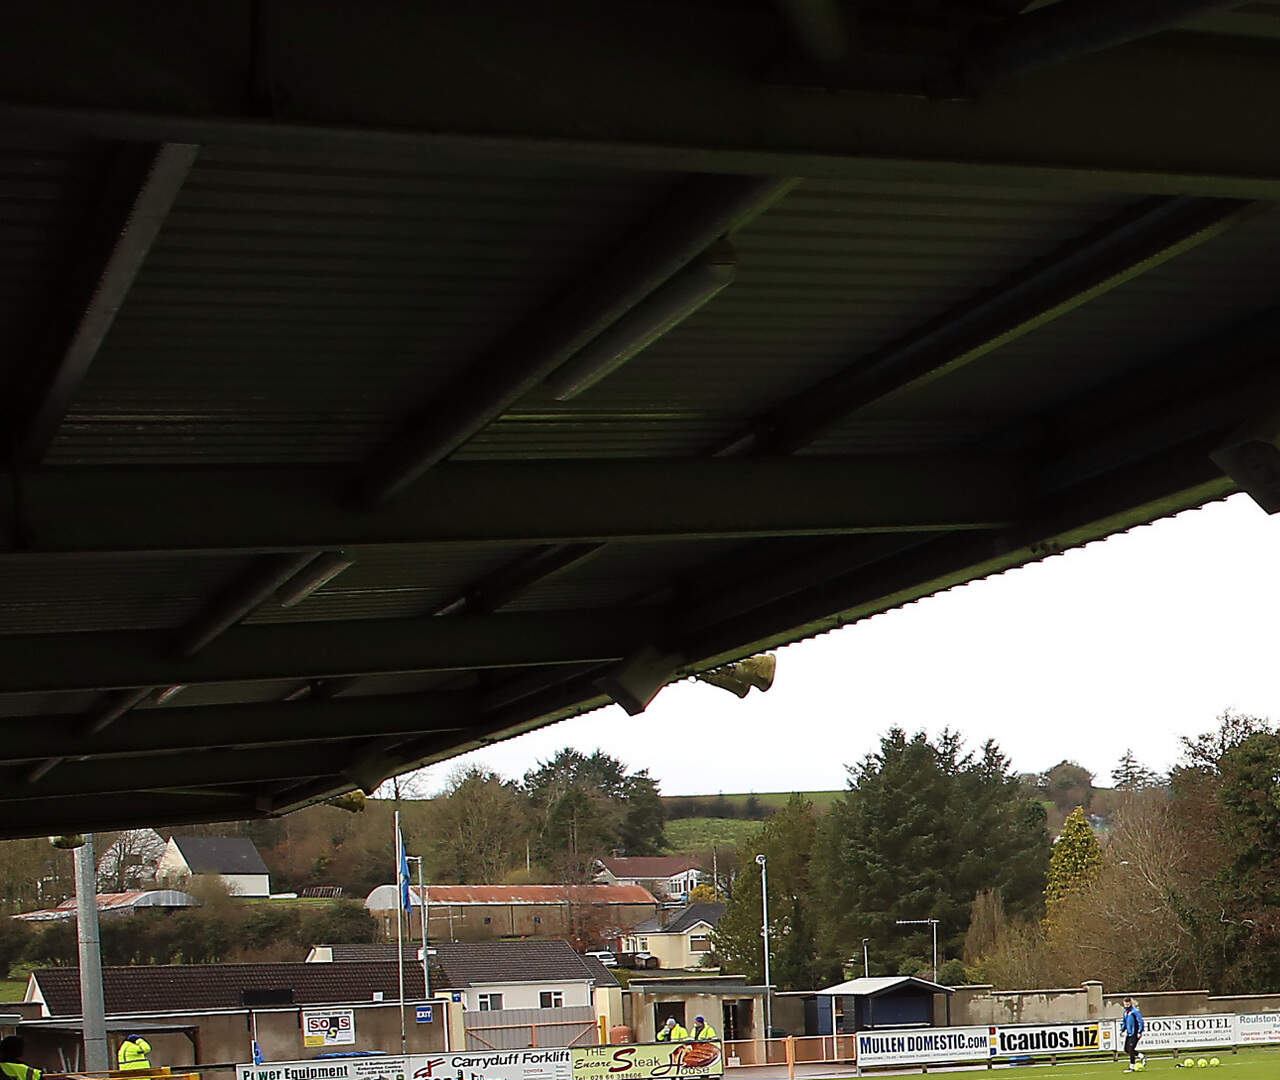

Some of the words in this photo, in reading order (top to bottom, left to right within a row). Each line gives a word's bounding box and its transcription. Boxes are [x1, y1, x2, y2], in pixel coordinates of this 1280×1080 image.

[1187, 1017, 1232, 1030] HOTEL
[860, 1036, 904, 1055] MULLEN
[1000, 1025, 1099, 1051] tcautos.biz
[452, 1052, 519, 1068] Carryduff
[522, 1050, 570, 1064] Forklift
[585, 1047, 607, 1057] THE
[574, 1058, 611, 1070] Encore
[609, 1048, 661, 1073] Steak
[651, 1053, 711, 1077] House
[285, 1065, 349, 1080] Equipment
